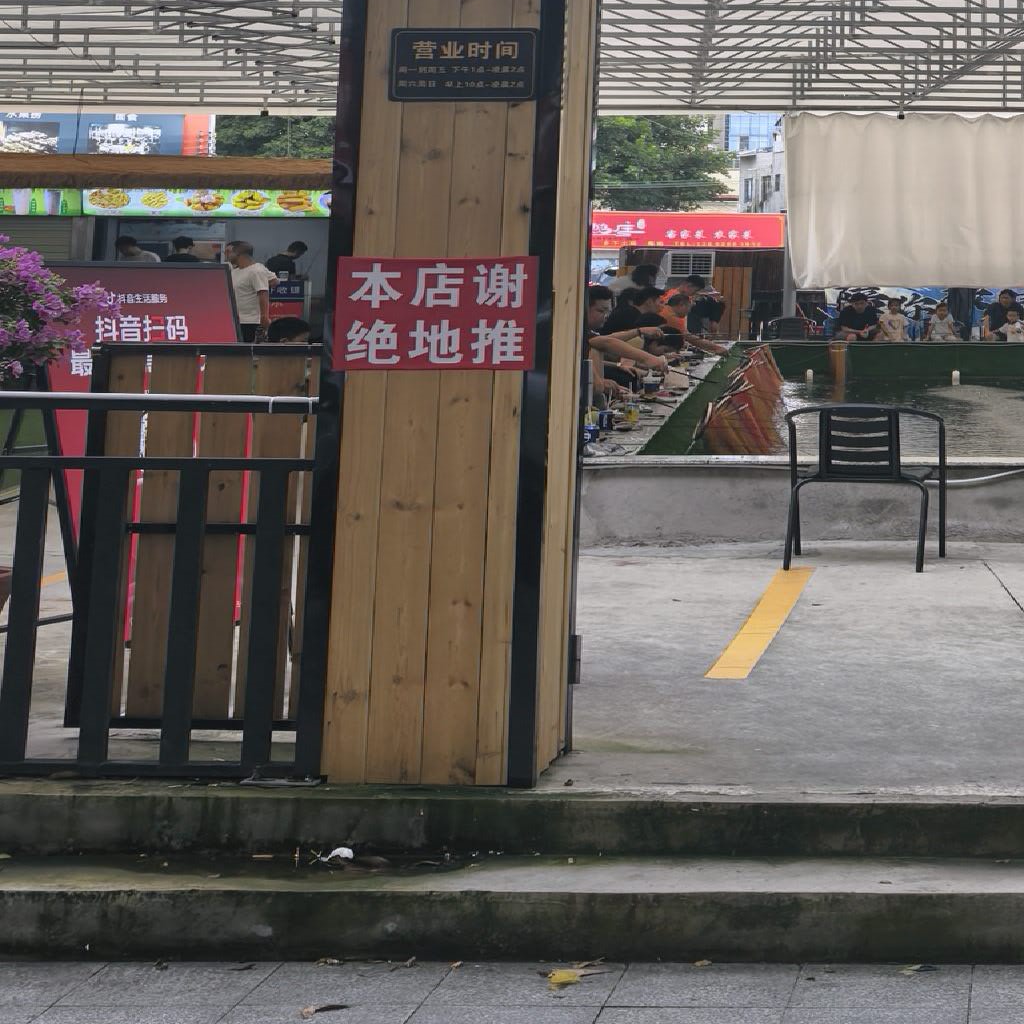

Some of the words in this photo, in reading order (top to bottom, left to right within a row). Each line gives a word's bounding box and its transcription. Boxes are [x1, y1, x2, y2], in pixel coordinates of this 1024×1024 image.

[412, 40, 520, 60] 营业时间
[348, 262, 529, 309] 本店谢
[95, 314, 189, 343] 抖音扫码
[345, 318, 526, 365] 绝地推
